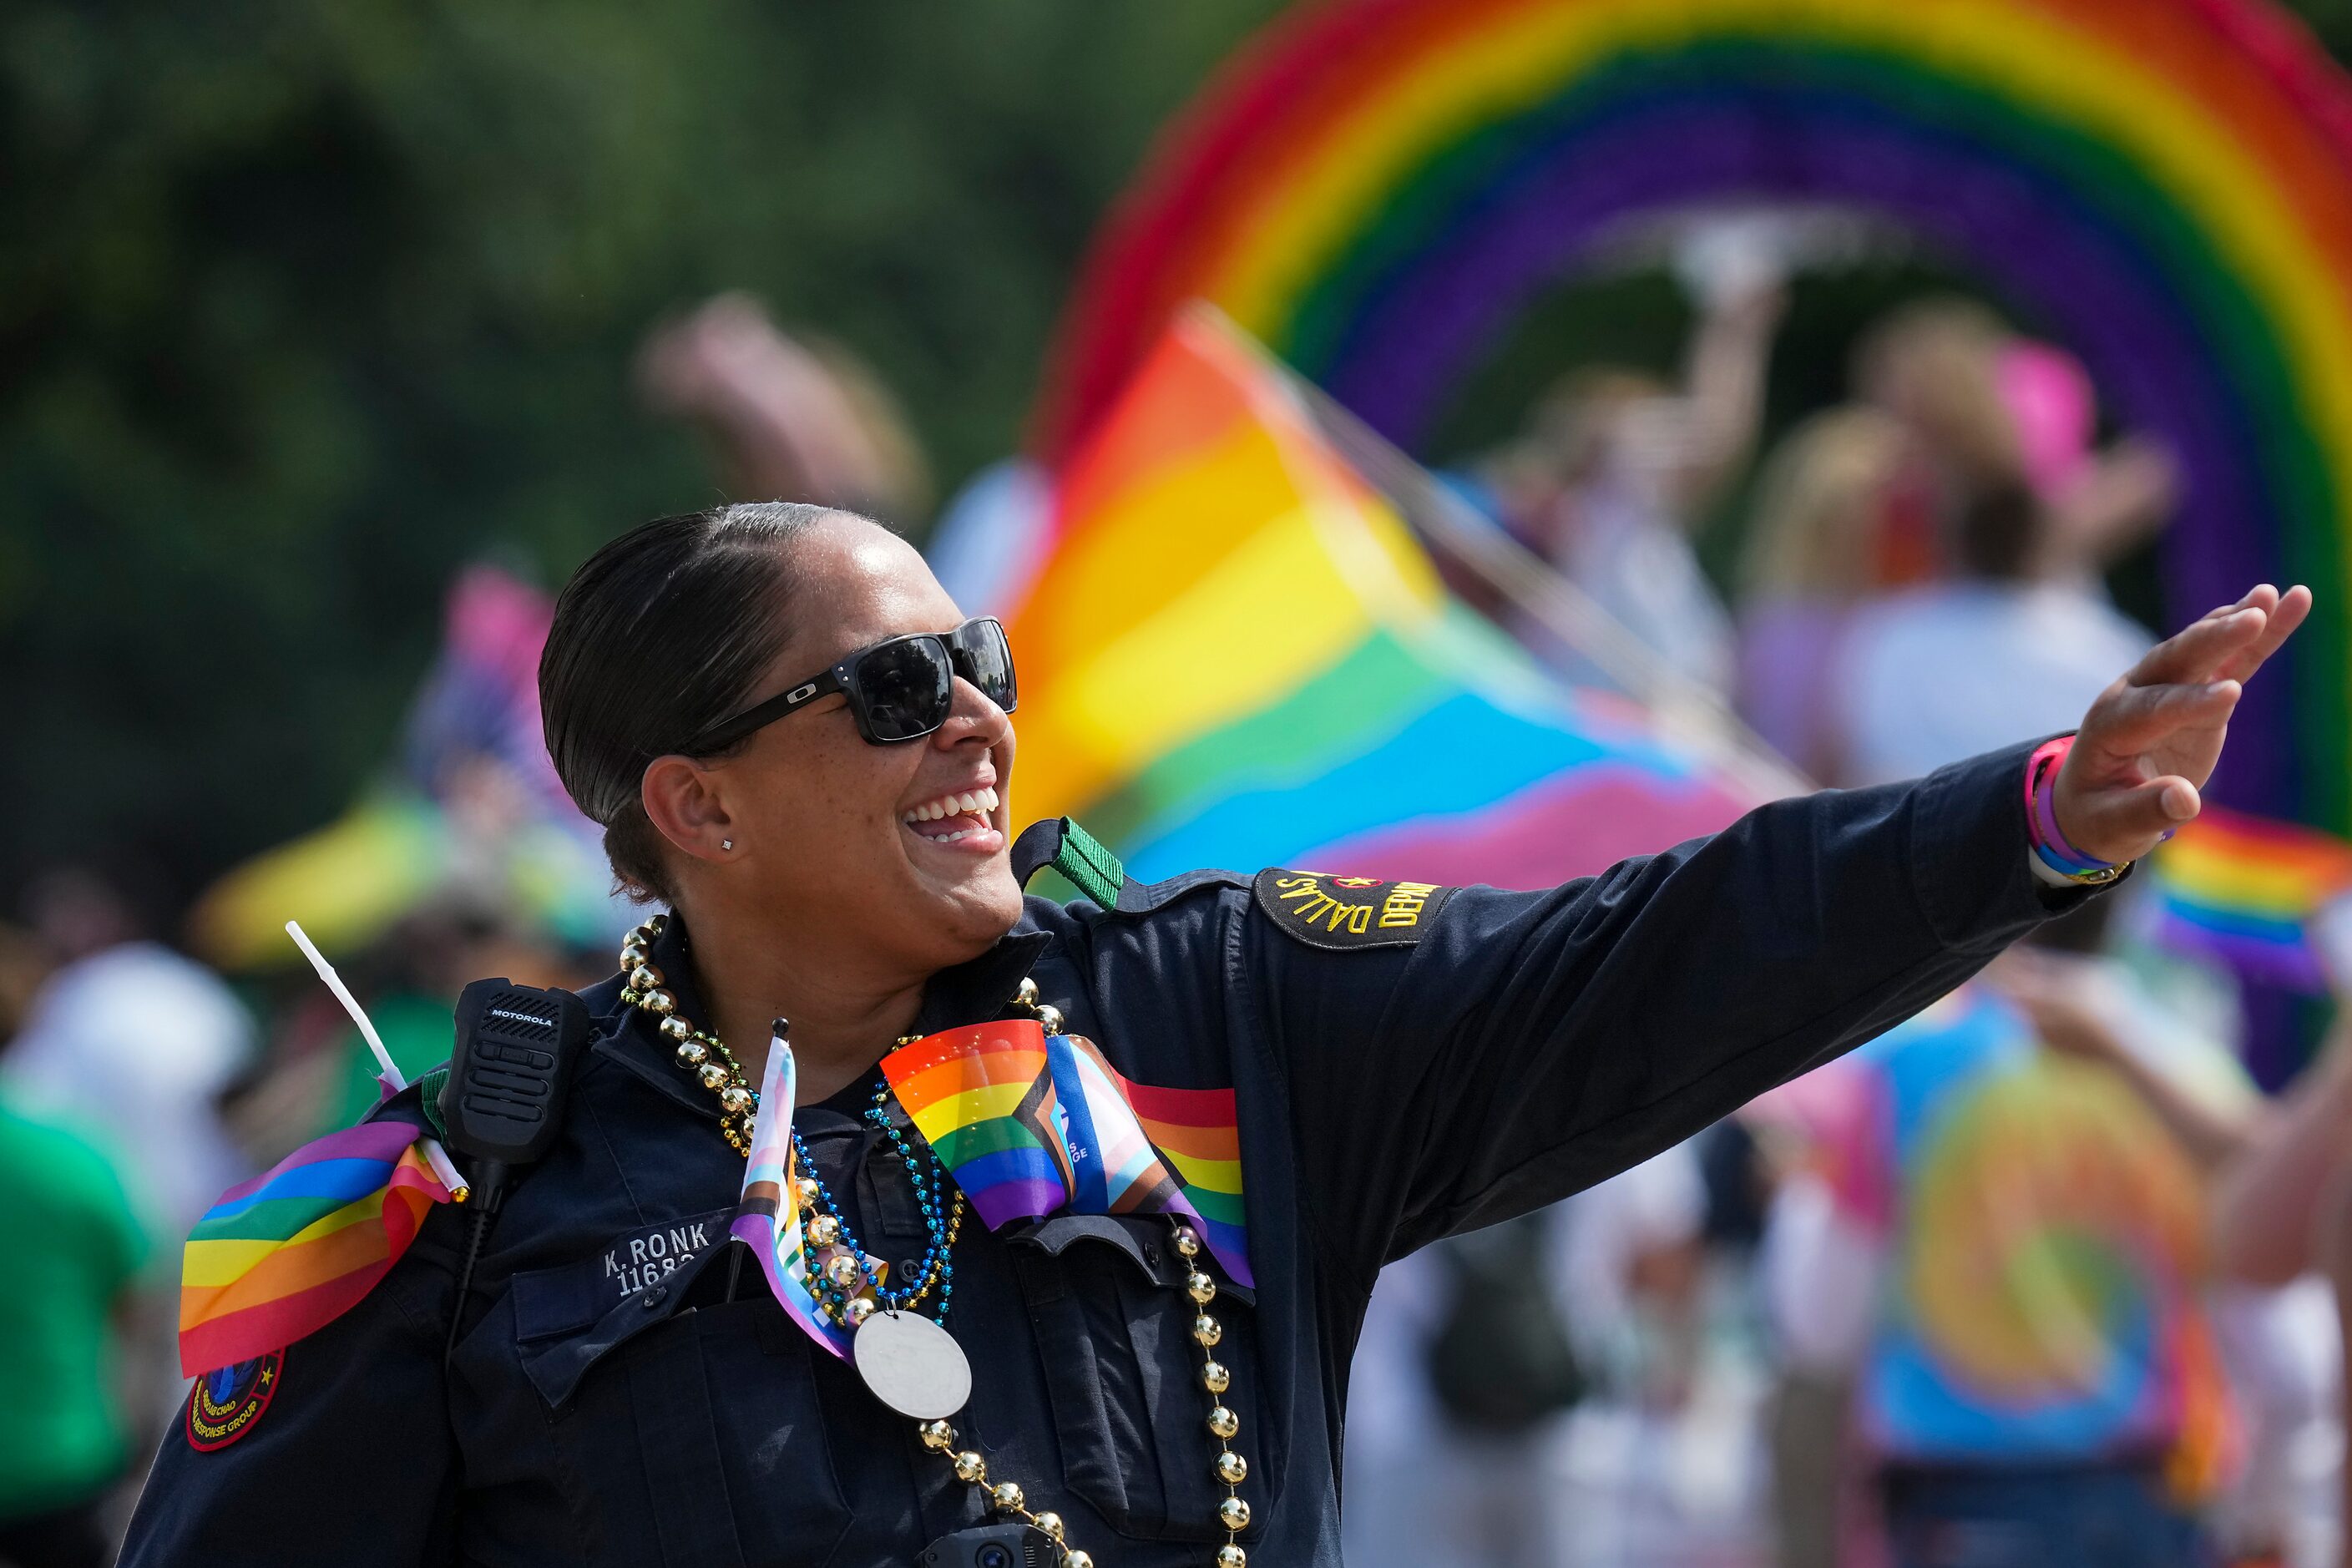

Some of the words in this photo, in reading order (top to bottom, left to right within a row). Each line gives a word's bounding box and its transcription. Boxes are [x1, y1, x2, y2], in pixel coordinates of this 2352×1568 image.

[1276, 878, 1374, 934] DALLAS
[492, 1009, 553, 1027] MOTOROLA
[616, 1253, 695, 1297] 1168
[227, 1400, 257, 1432] GROUP
